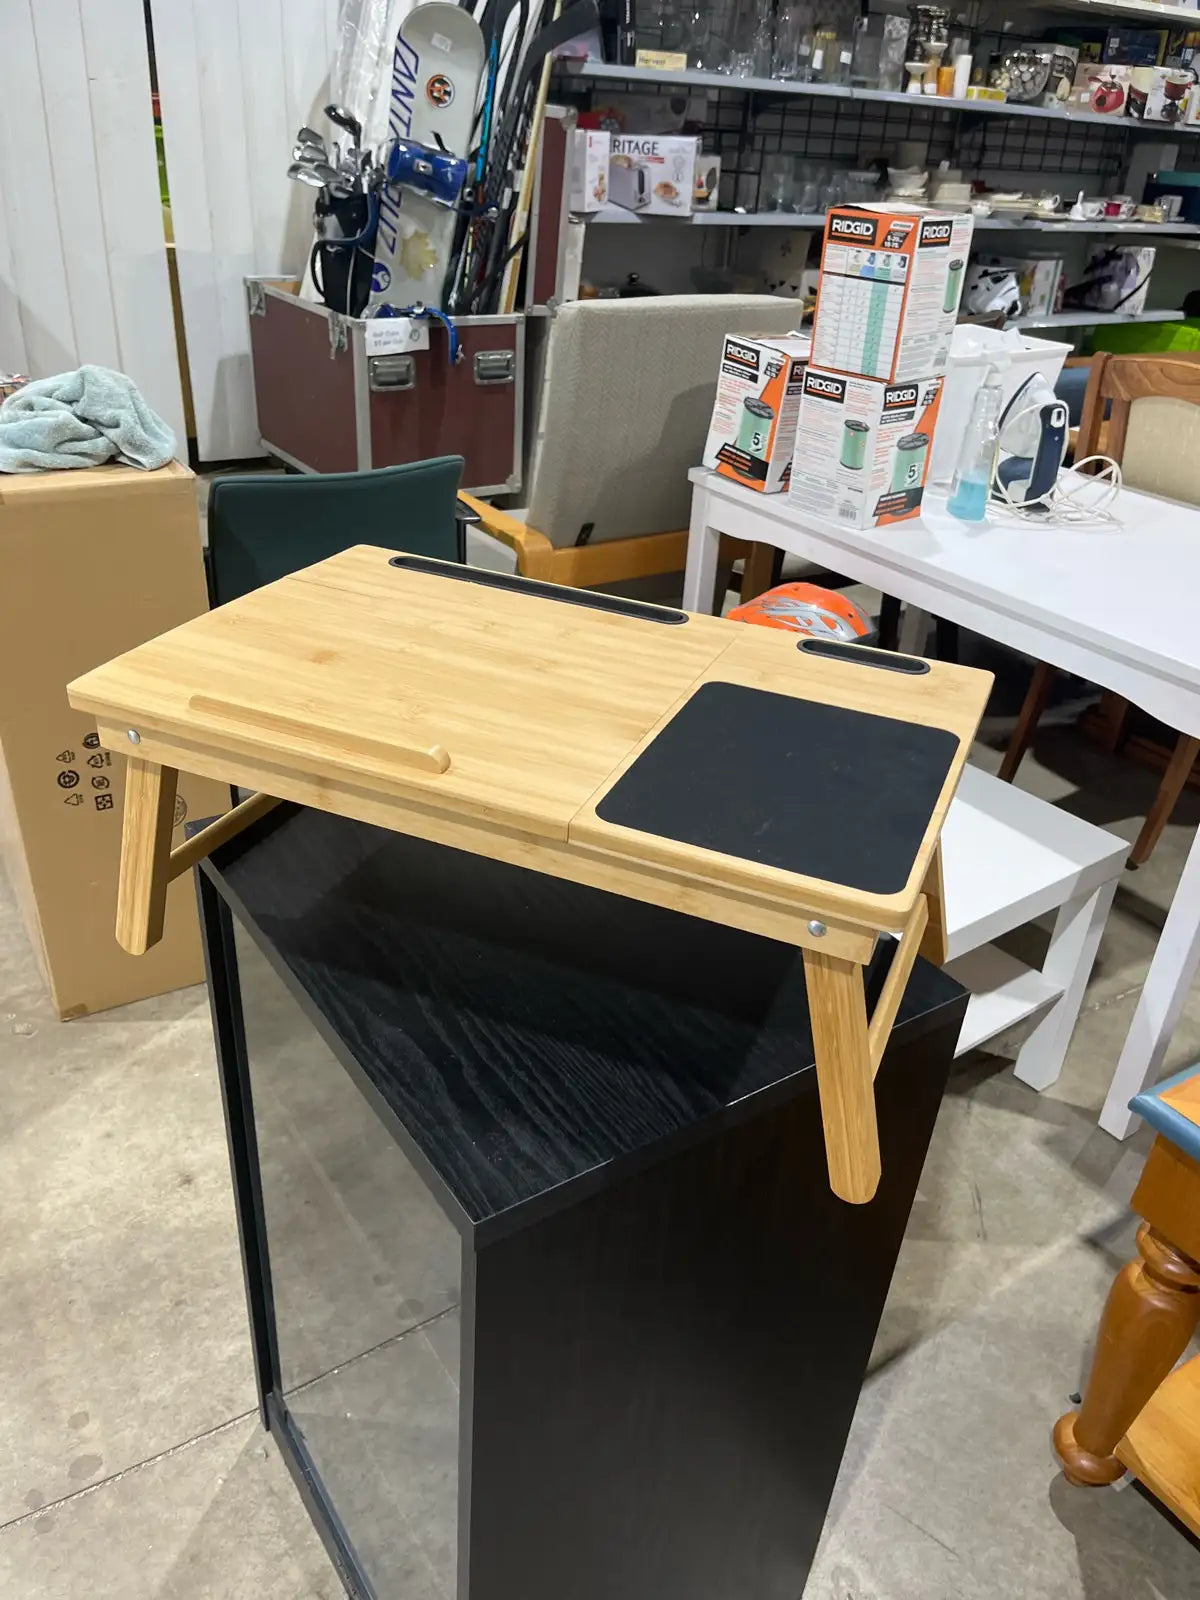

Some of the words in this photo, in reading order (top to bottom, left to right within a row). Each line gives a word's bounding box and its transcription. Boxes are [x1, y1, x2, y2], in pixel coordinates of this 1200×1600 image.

[610, 139, 660, 156] RITAGE
[831, 219, 874, 236] RIDGID
[922, 225, 950, 239] RIDGID
[726, 344, 757, 363] RIDGID
[806, 376, 843, 395] RIDGID
[886, 388, 917, 404] RIDGID
[752, 432, 760, 446] 5
[908, 464, 916, 479] 5
